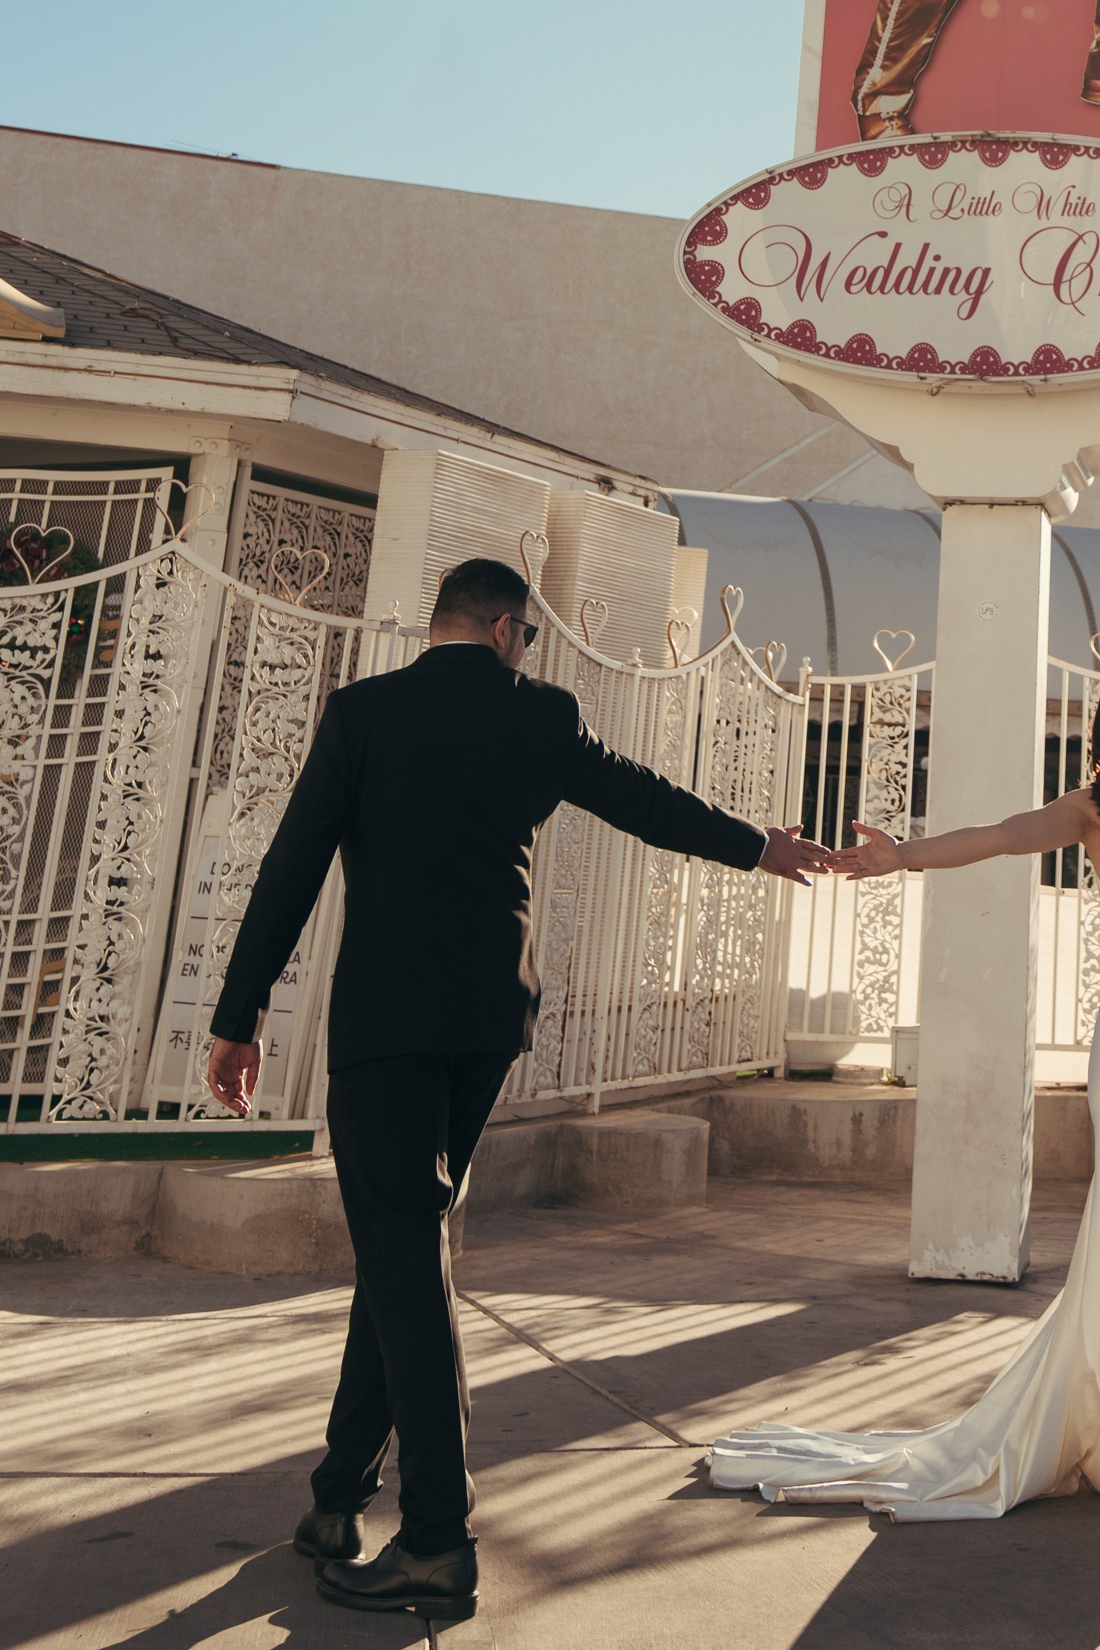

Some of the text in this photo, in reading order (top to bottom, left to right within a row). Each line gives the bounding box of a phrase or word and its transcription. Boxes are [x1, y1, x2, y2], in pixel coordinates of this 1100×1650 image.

[872, 181, 1097, 223] A Little White
[737, 223, 994, 322] Wedding
